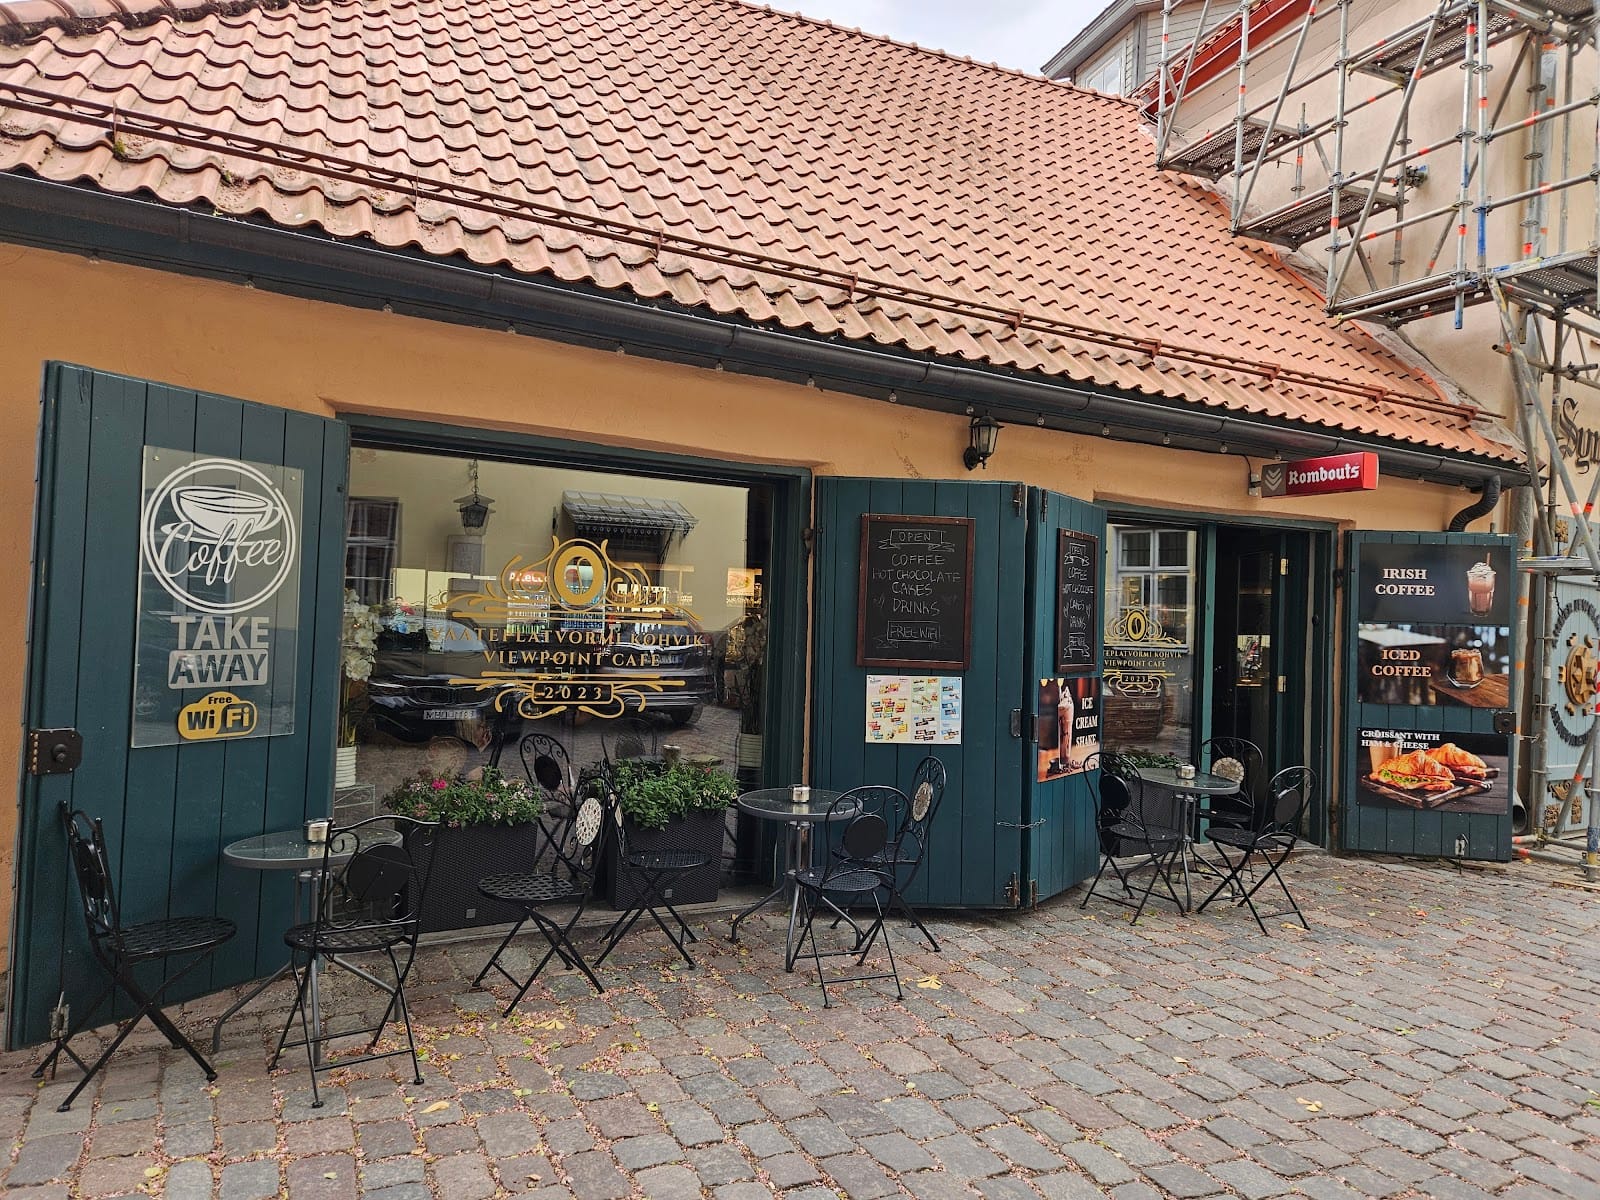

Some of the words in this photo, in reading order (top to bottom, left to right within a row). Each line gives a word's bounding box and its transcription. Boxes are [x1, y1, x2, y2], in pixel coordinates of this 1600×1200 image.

[1288, 462, 1360, 485] Rombouts
[898, 532, 931, 541] OPEN
[160, 518, 285, 586] Coffee
[891, 554, 945, 566] COFFEE
[872, 568, 894, 580] HOT
[896, 569, 961, 583] CHOCOLATE
[1383, 568, 1427, 580] IRISH
[891, 581, 933, 596] CAKES
[1375, 584, 1435, 597] COFFEE
[893, 598, 941, 617] DRINKS
[171, 616, 270, 650] TAKE
[631, 633, 703, 646] KOHVIK
[483, 650, 602, 666] VIEWPOINT
[612, 653, 660, 667] CAFE
[1381, 649, 1421, 661] ICED
[170, 653, 267, 684] AWAY
[1104, 659, 1146, 667] VIEWPOINT
[1371, 665, 1432, 677] COFFEE
[545, 686, 602, 699] 2023
[208, 696, 233, 705] Free
[1081, 697, 1094, 710] ICE
[1075, 715, 1098, 729] CREAM
[1075, 734, 1097, 748] SHAKE
[1361, 730, 1413, 739] CROISSANT
[1414, 732, 1440, 741] WITH
[1393, 741, 1430, 750] CHEESE
